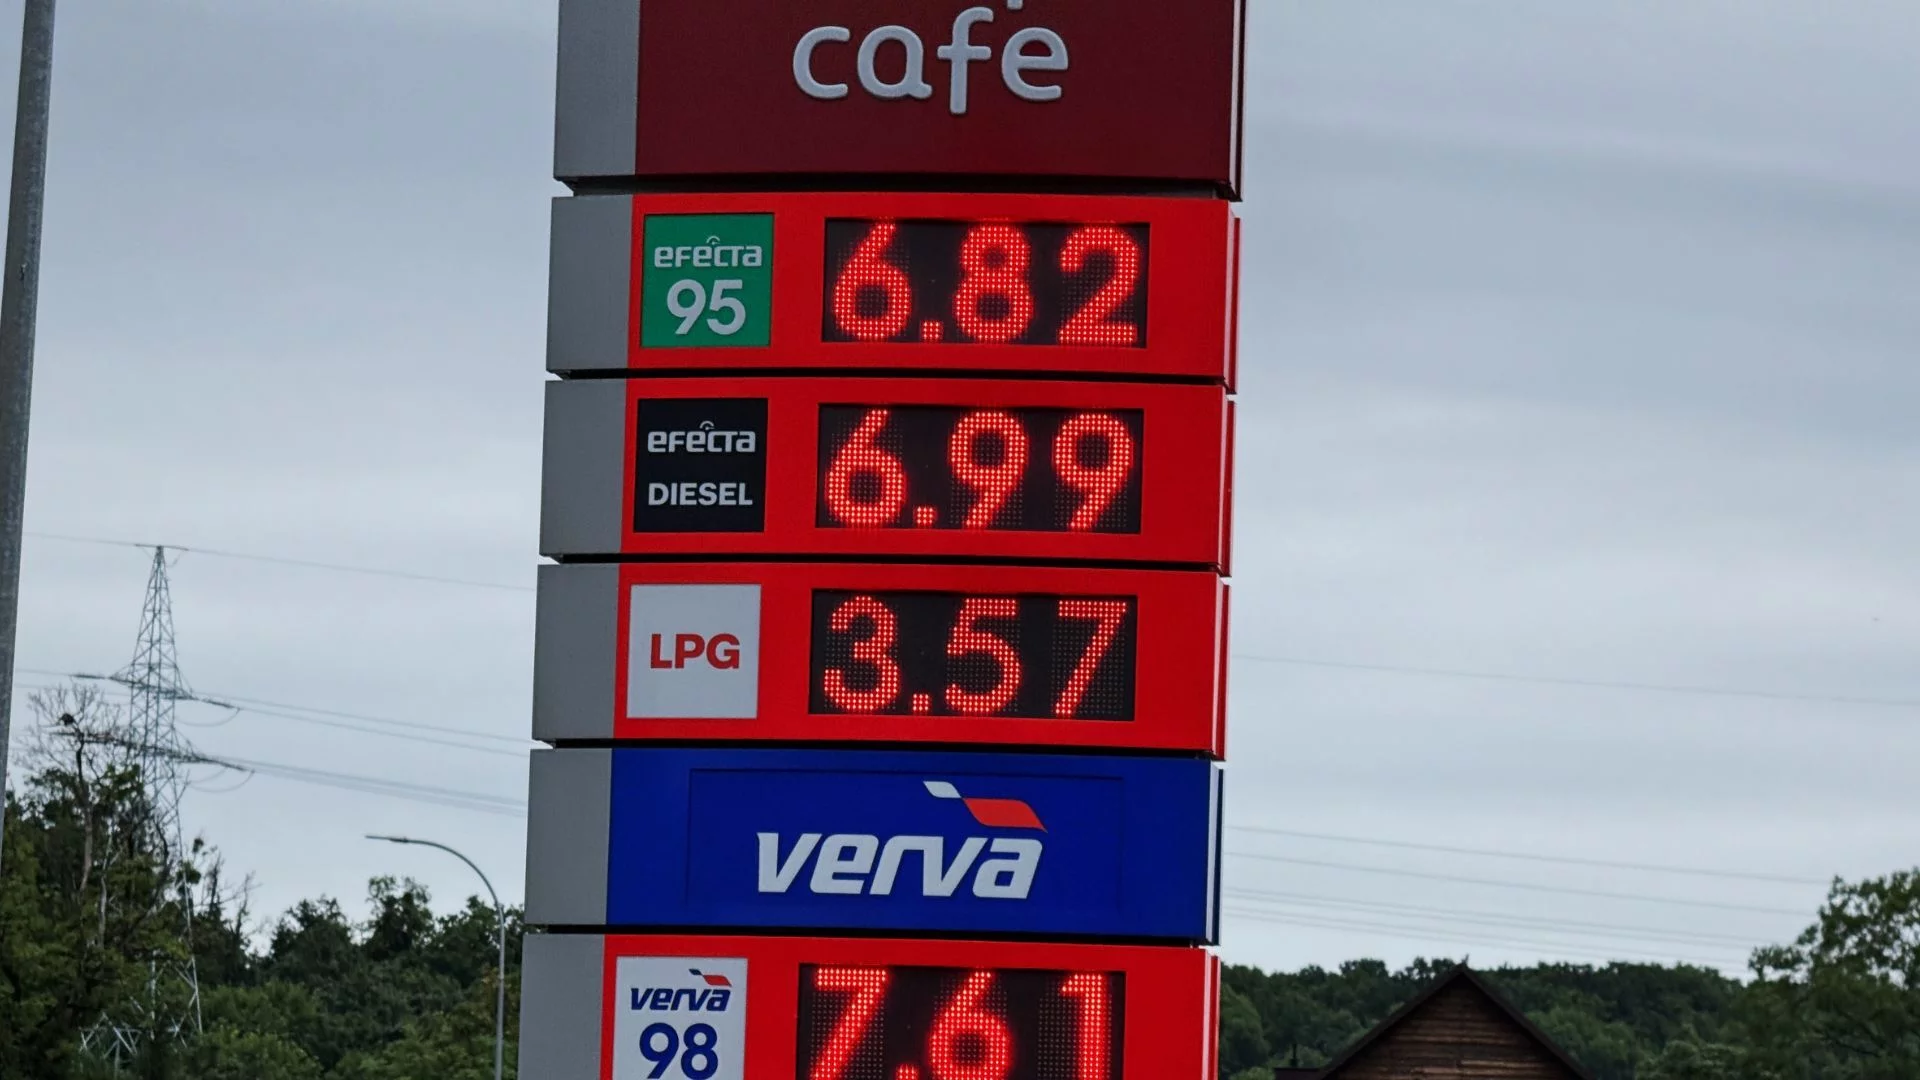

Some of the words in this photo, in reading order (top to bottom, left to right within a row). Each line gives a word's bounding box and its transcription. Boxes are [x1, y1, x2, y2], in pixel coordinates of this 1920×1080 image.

[666, 279, 746, 336] 95
[831, 220, 1142, 344] 6.82
[647, 483, 754, 507] DIESEL
[825, 408, 1135, 531] 6.99
[649, 633, 741, 670] LPG
[822, 595, 1128, 717] 3.57
[757, 832, 1043, 899] verva
[630, 987, 733, 1012] verva
[809, 967, 1112, 1080] 7.61
[638, 1022, 719, 1080] 98
